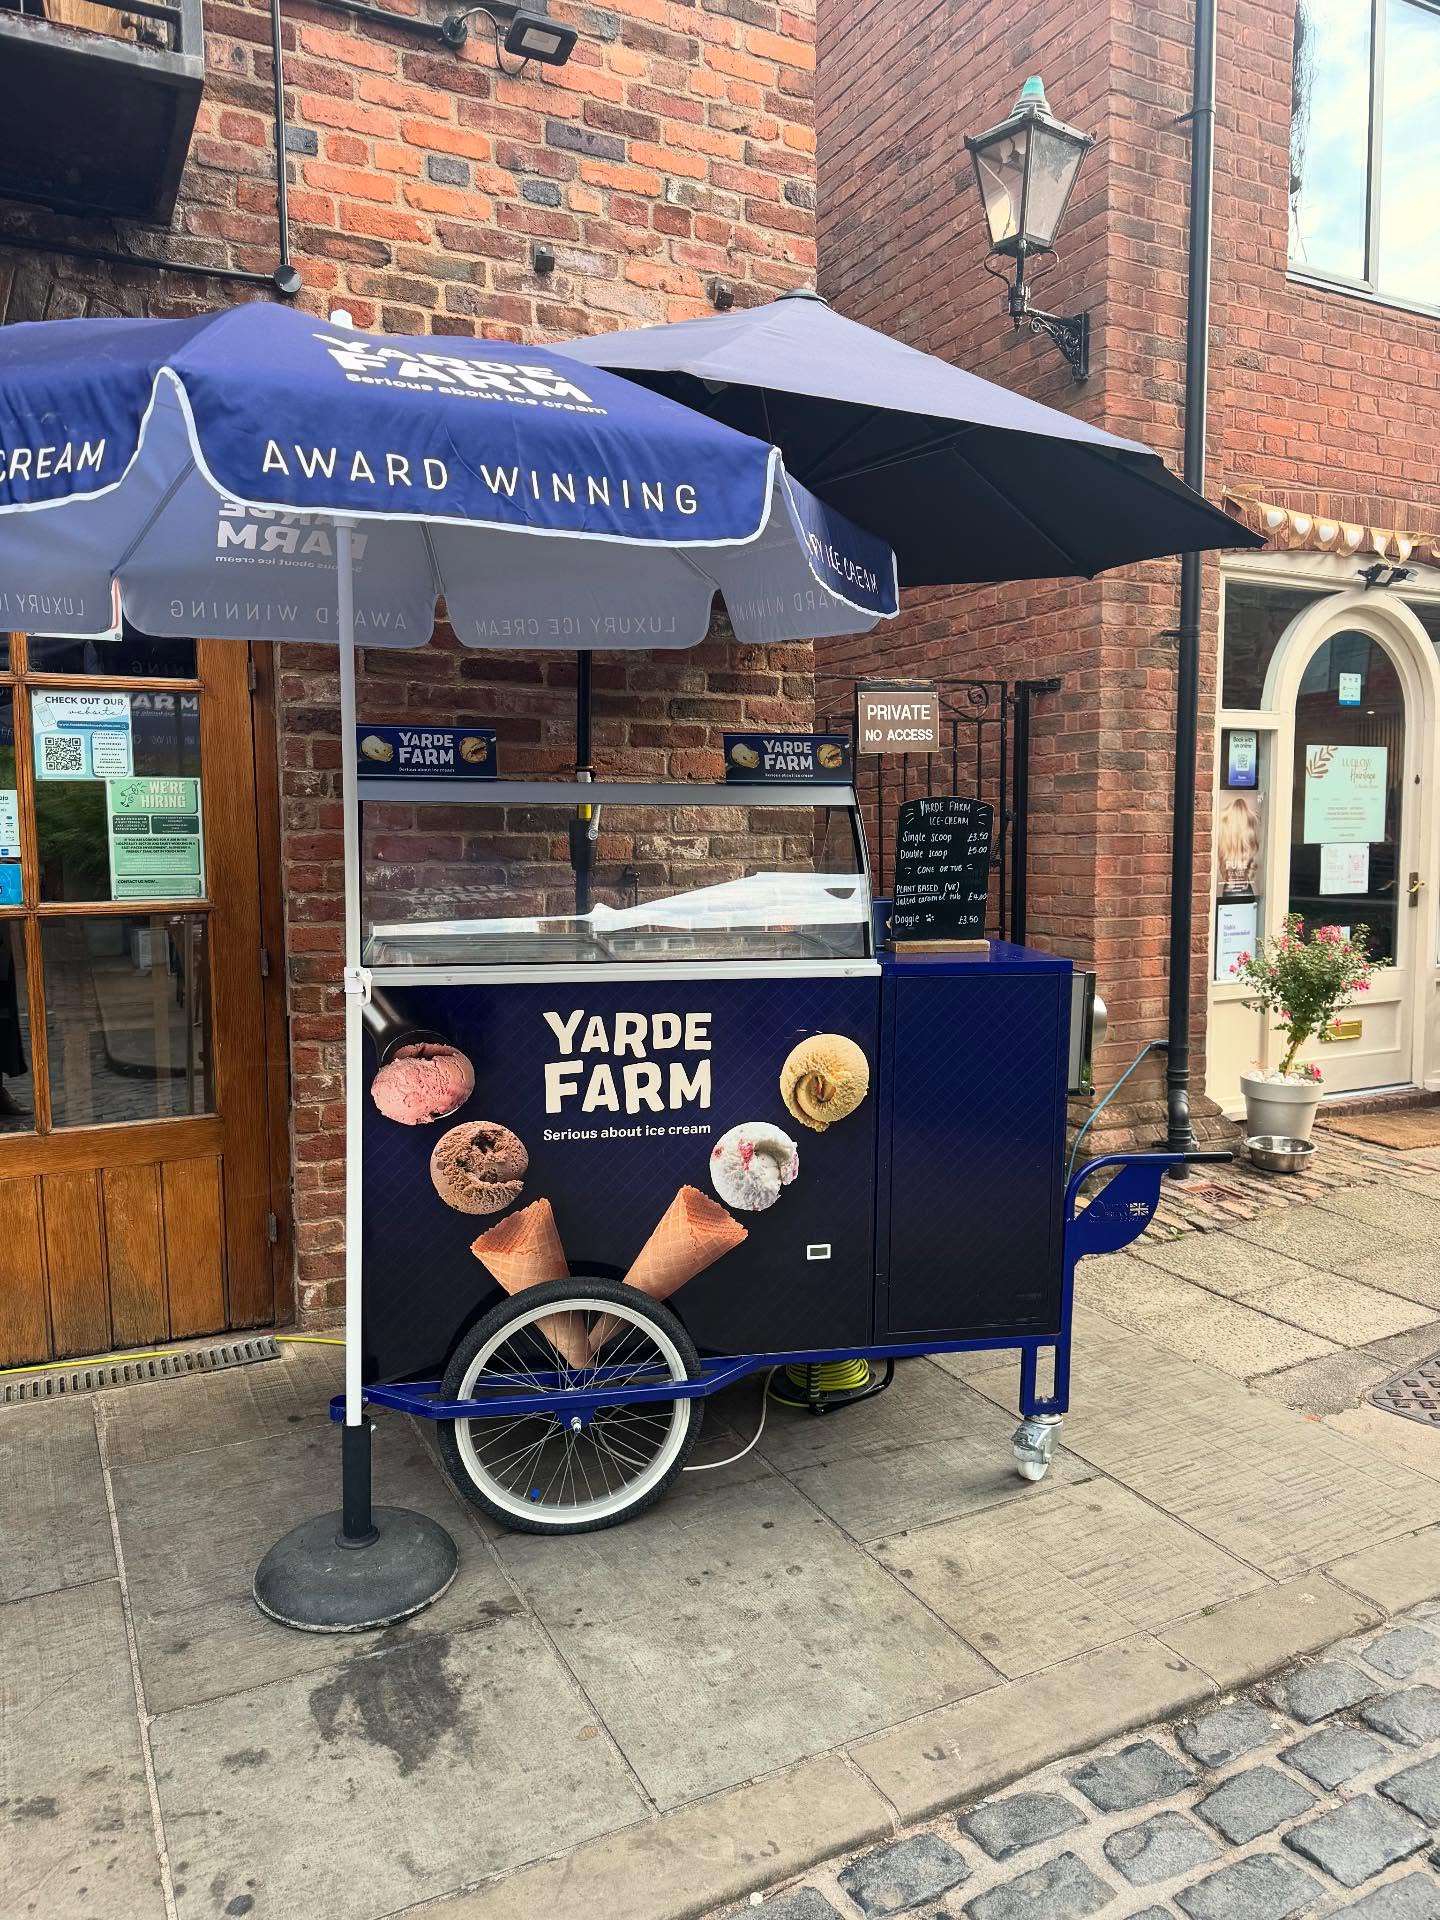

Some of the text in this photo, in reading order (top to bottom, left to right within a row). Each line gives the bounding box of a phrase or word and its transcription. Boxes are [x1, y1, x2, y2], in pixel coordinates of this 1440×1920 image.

[312, 333, 566, 382] YARDE
[327, 349, 593, 403] FARM
[346, 373, 608, 415] Serious about ice cream
[262, 440, 698, 515] AWARD WINNING
[843, 557, 879, 594] CREAM
[45, 696, 124, 706] CHECK OUT OUR
[866, 704, 931, 721] PRIVATE
[398, 732, 454, 748] YARDE
[865, 729, 934, 742] NO ACCESS
[763, 740, 812, 755] YARDE
[399, 747, 454, 765] FARM
[764, 754, 814, 771] FARM
[149, 781, 186, 794] WE'RE
[141, 794, 186, 809] HIRING
[920, 800, 971, 816] YARDE FARM
[929, 816, 969, 826] ICE-CREAM
[902, 831, 926, 846] Single
[967, 832, 989, 843] £3.50
[900, 849, 924, 860] Double
[967, 846, 988, 856] £5.00
[917, 864, 963, 874] CONE OR TUB
[896, 884, 916, 894] PLANT
[917, 884, 939, 893] BASED
[894, 913, 979, 927] Doggie £3.50
[542, 1009, 712, 1059] YARDE
[544, 1058, 712, 1115] FARM
[543, 1124, 711, 1141] Serious about ice cream
